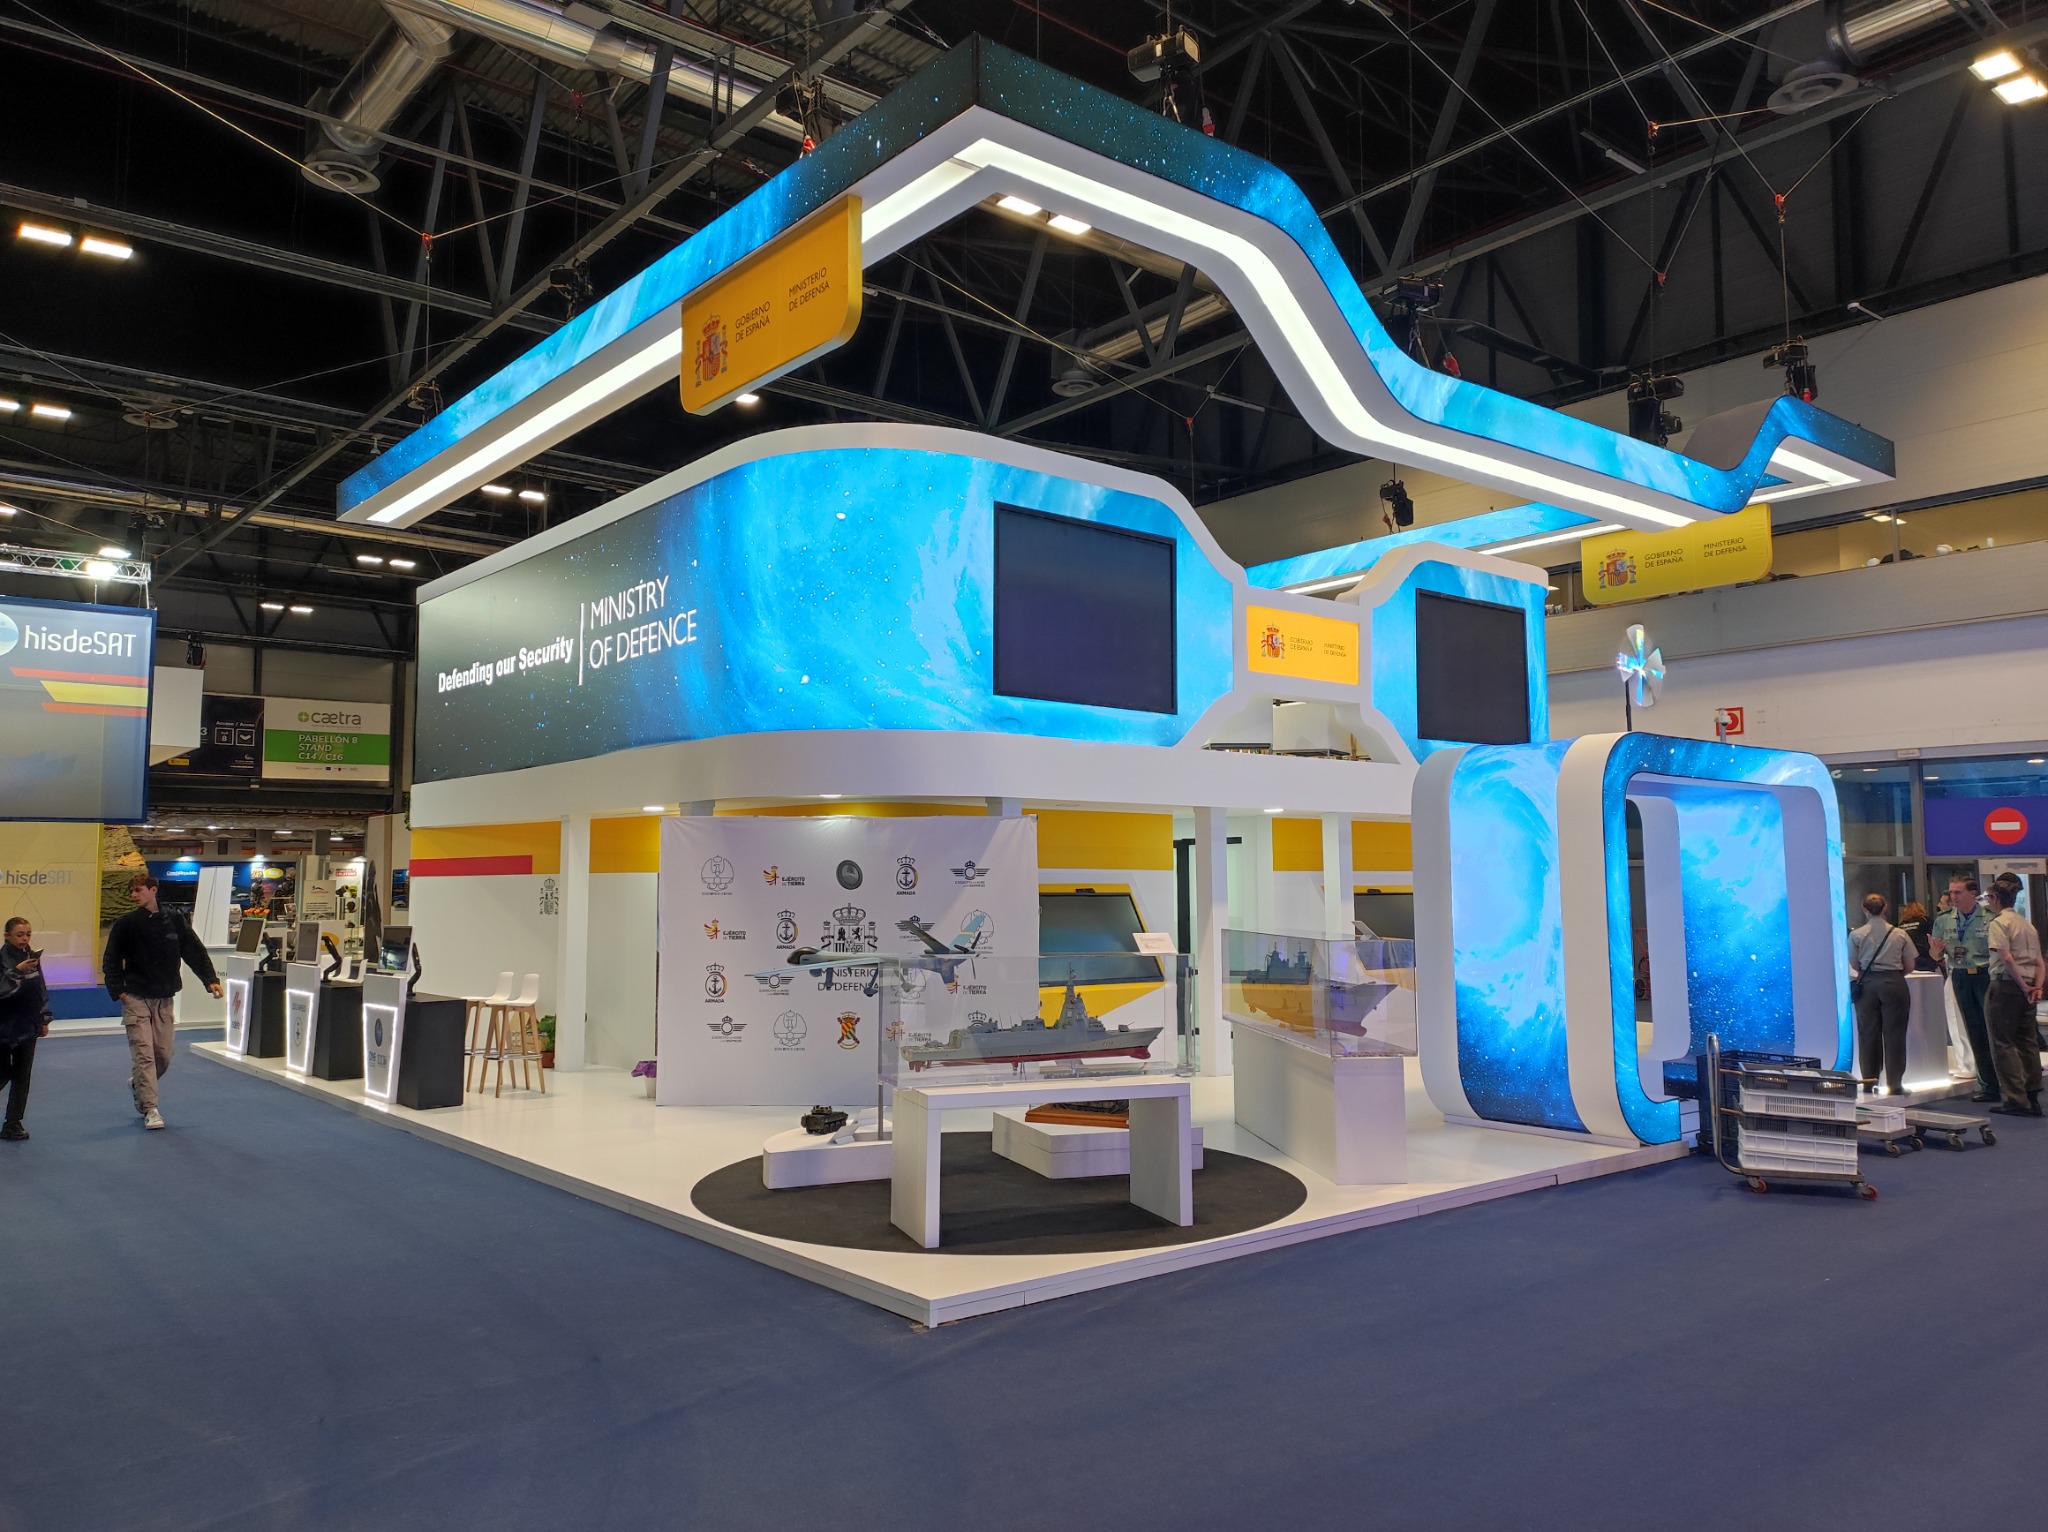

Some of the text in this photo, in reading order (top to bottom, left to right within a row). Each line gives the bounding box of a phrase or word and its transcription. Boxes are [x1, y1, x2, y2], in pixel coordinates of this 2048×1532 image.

[788, 267, 827, 298] MINISTERIO
[789, 281, 830, 312] DE DEFENSA
[735, 301, 771, 329] GOBIERNO
[735, 315, 770, 343] DE ESPAÑA
[1703, 537, 1744, 549] MINISTERIO
[1715, 545, 1747, 556] DEFENSA
[1644, 548, 1683, 561] GOBIERNO
[1656, 556, 1684, 567] ESPAÑA
[591, 575, 670, 630] MINISTRY
[24, 624, 137, 657] hisdeSAT
[589, 609, 698, 669] OF DEFENCE
[438, 635, 574, 693] Defending our Security
[298, 734, 358, 744] PABELLÓN 8
[298, 743, 332, 752] STAND
[298, 752, 317, 760] C14
[325, 753, 344, 761] C16
[5, 869, 74, 885] hisdeSAT
